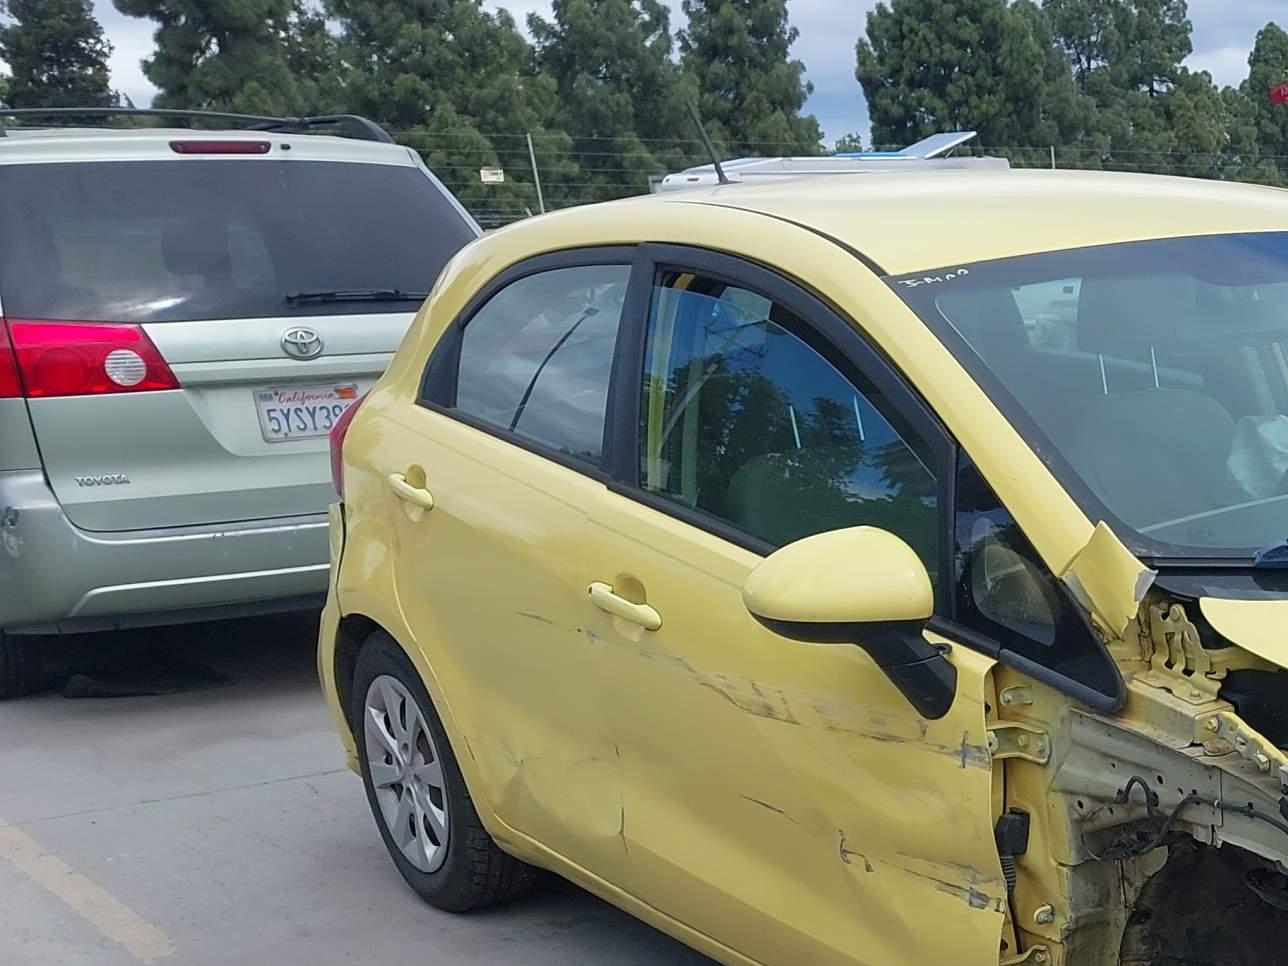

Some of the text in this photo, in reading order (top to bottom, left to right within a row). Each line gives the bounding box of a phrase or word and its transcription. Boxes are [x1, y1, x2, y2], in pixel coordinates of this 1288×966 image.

[278, 390, 334, 405] California
[266, 403, 349, 433] 5YSY39
[74, 474, 130, 487] TOYOTA
